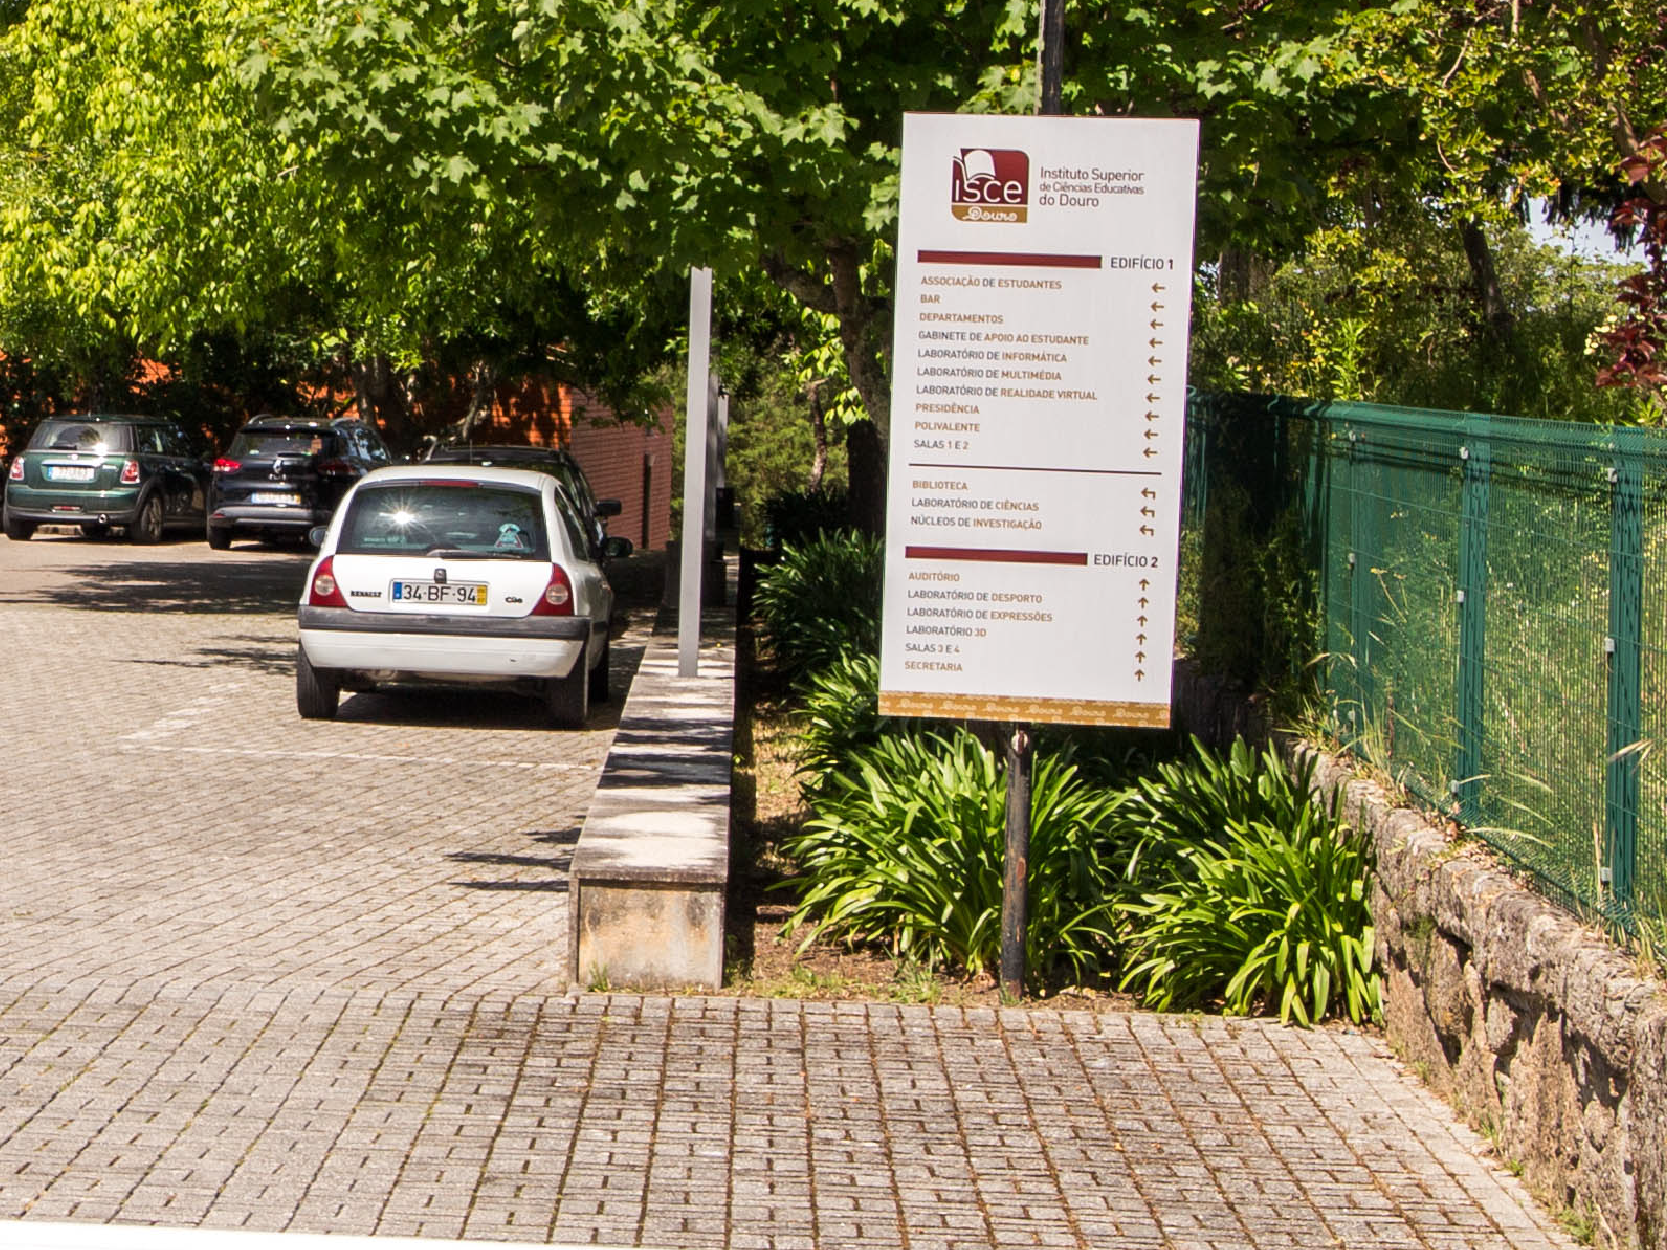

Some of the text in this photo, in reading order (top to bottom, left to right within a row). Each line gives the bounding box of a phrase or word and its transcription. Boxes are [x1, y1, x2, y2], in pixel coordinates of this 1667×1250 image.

[1040, 166, 1144, 182] Instituto Superior
[1040, 182, 1144, 195] de Ciências Educativas
[1040, 195, 1054, 206] do
[1110, 256, 1174, 270] EDIFÍCIO 1
[921, 275, 1062, 289] ASSOCIAÇÃO DE ESTUDANTES
[920, 294, 940, 304] BAR
[919, 313, 1004, 324] DEPARTAMENTOS
[918, 331, 1089, 345] GABINETE DE APOIO AO ESTUDANTE
[918, 349, 1067, 362] LABORATÓRIO DE INFORMÁTICA
[917, 367, 1062, 380] LABORATÓRIO DE MULTIMÉDIA
[916, 385, 1097, 400] LABORATÓRIO DE REALIDADE VIRTUAL
[915, 402, 980, 414] PRESIDÊNCIA
[915, 421, 980, 432] POLIVALENTE
[914, 439, 968, 450] SALAS 1 E 2
[913, 480, 968, 491] BIBLIOTECA
[912, 497, 1039, 511] LABORATÓRIO DE CIÊNCIAS
[911, 515, 1042, 531] NÚCLEOS DE INVESTIGAÇÃO
[1094, 552, 1158, 568] EDIFÍCIO 2
[909, 571, 960, 582] AUDITÓRIO
[908, 589, 1042, 603] LABORATÓRIO DE DESPORTO
[907, 607, 1052, 622] LABORATÓRIO DE EXPRESSÕES
[906, 625, 972, 637] LABORATÓRIO
[906, 642, 936, 653] SALAS
[946, 644, 952, 653] E
[905, 661, 963, 672] SECRETARIA
